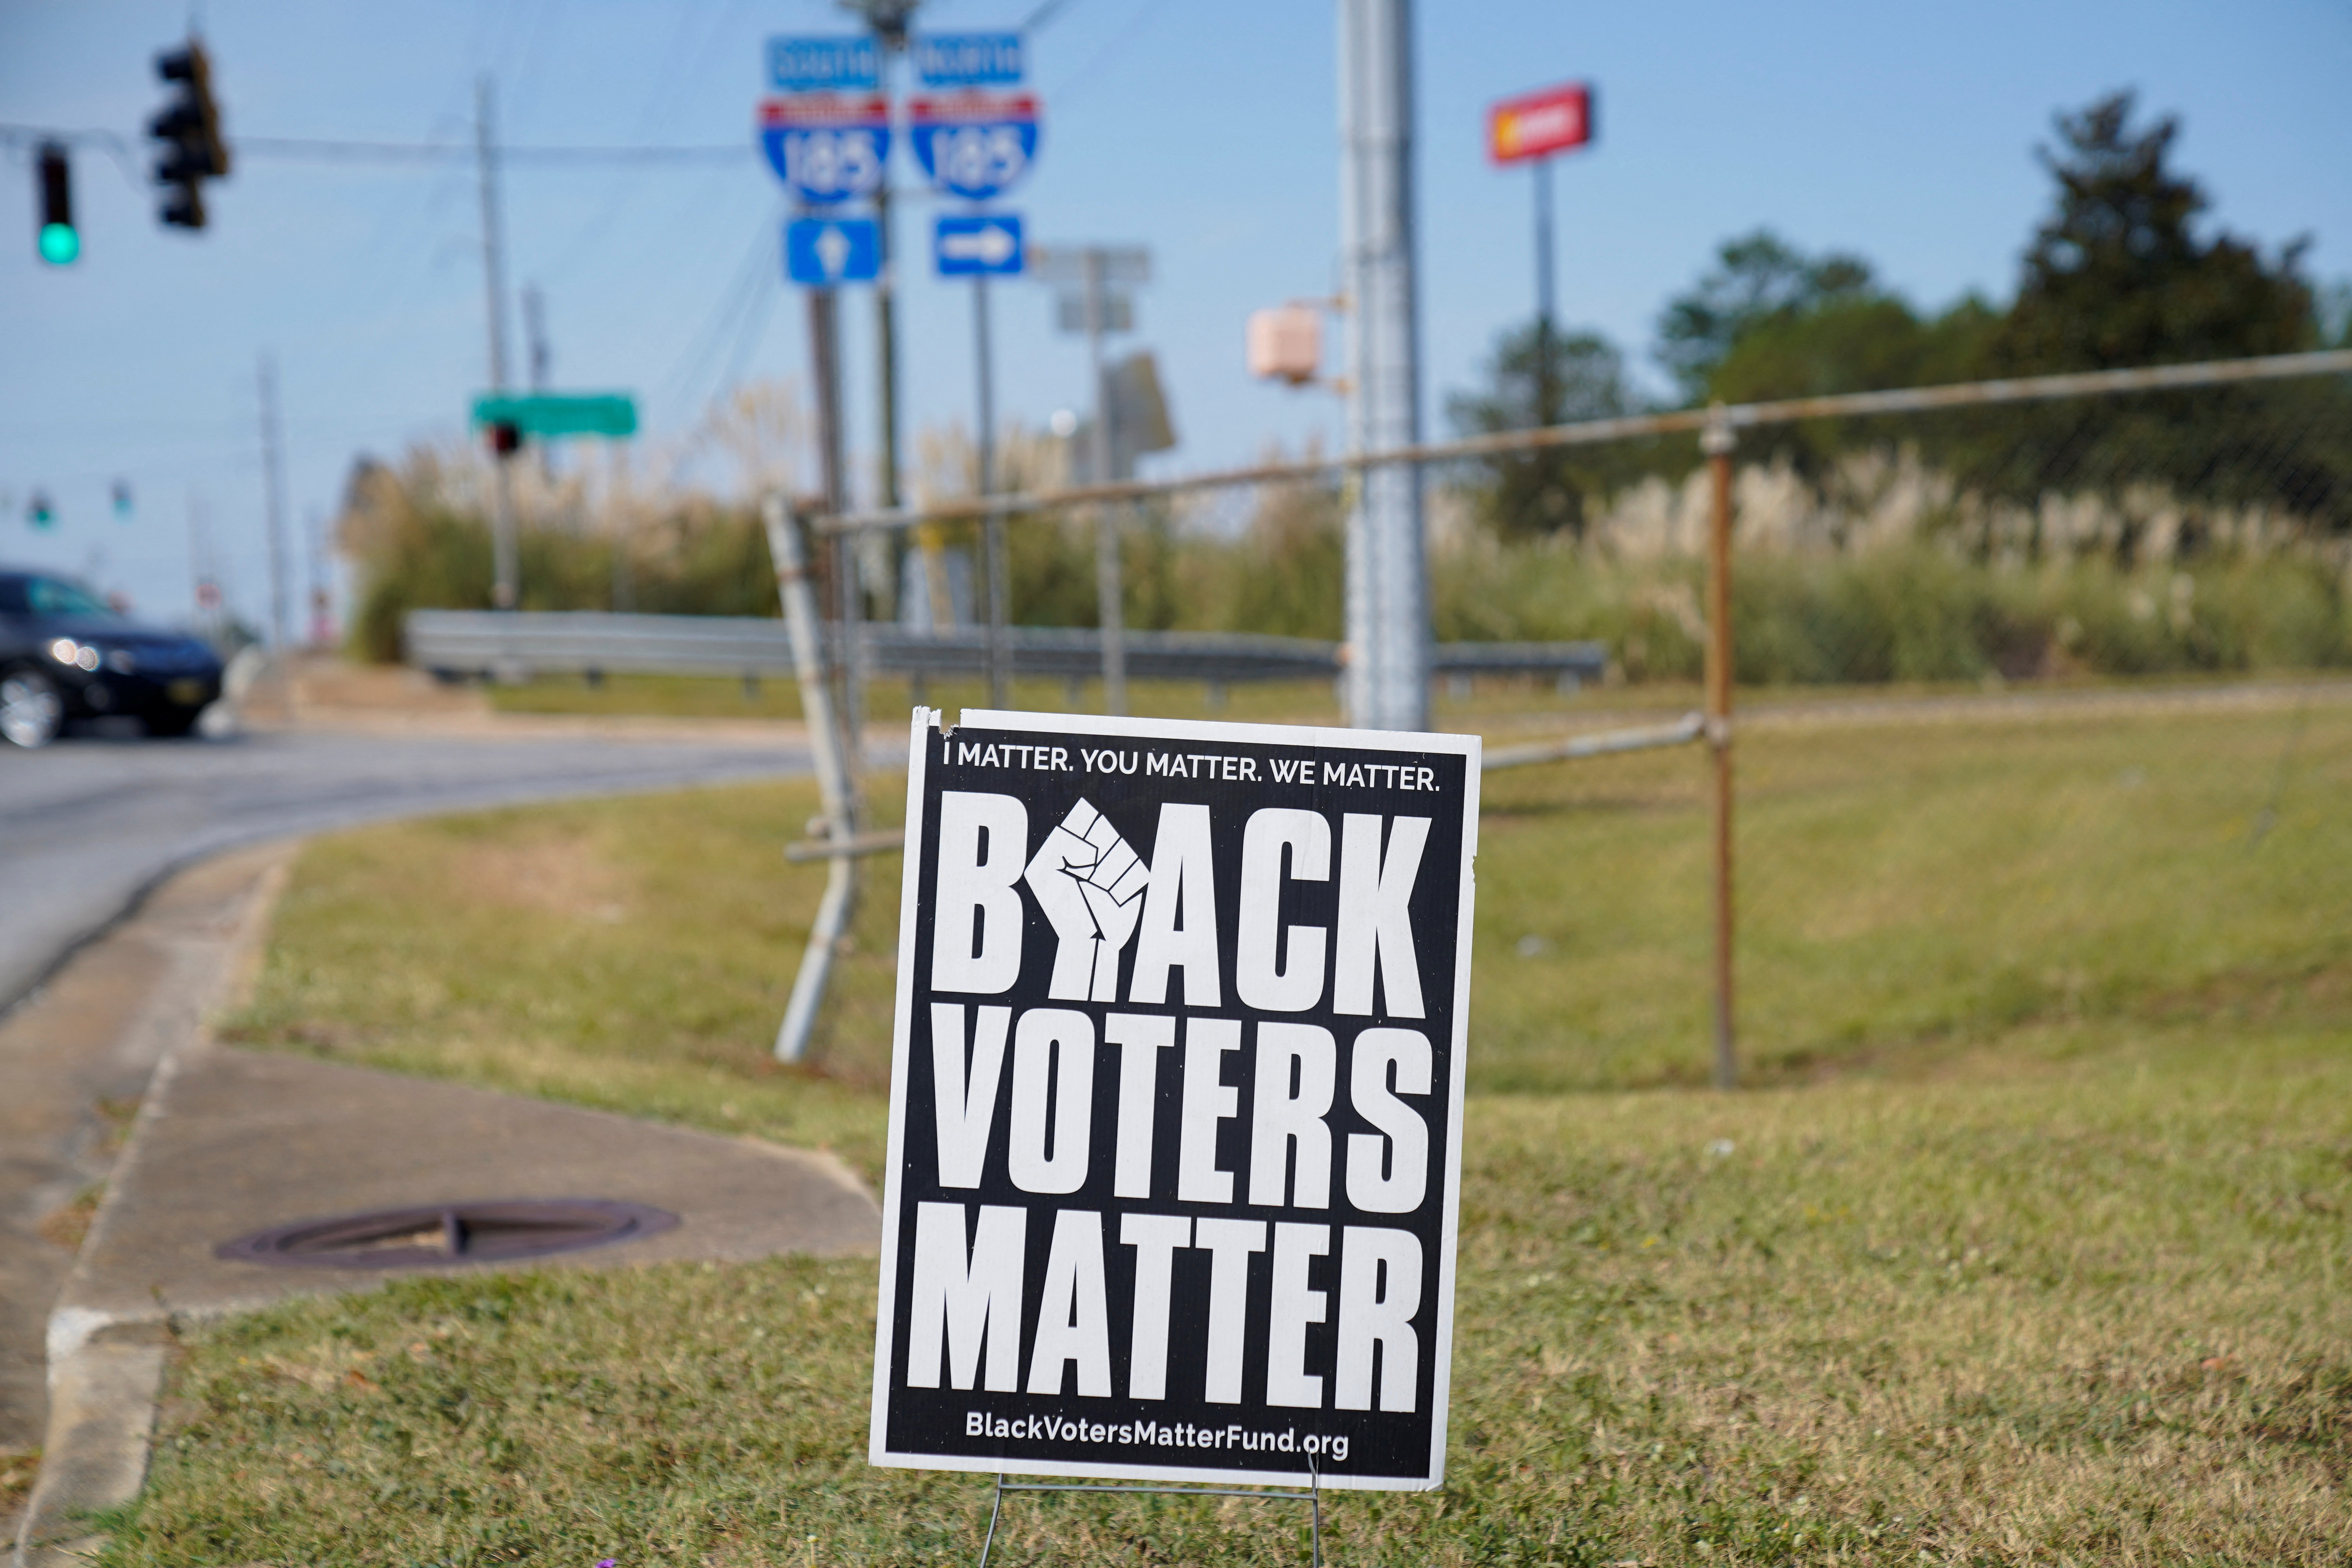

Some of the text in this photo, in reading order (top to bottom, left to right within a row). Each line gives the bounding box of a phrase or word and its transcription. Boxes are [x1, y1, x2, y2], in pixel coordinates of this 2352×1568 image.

[783, 129, 881, 192] 185
[931, 126, 1025, 189] 185
[944, 742, 1439, 792] I MATTER. YOU MATTER. WE MATTER.
[931, 1002, 1433, 1213] VOTERS
[907, 1201, 1423, 1413] MATTER
[966, 1412, 1349, 1461] BlackVotersMatterFund.org
